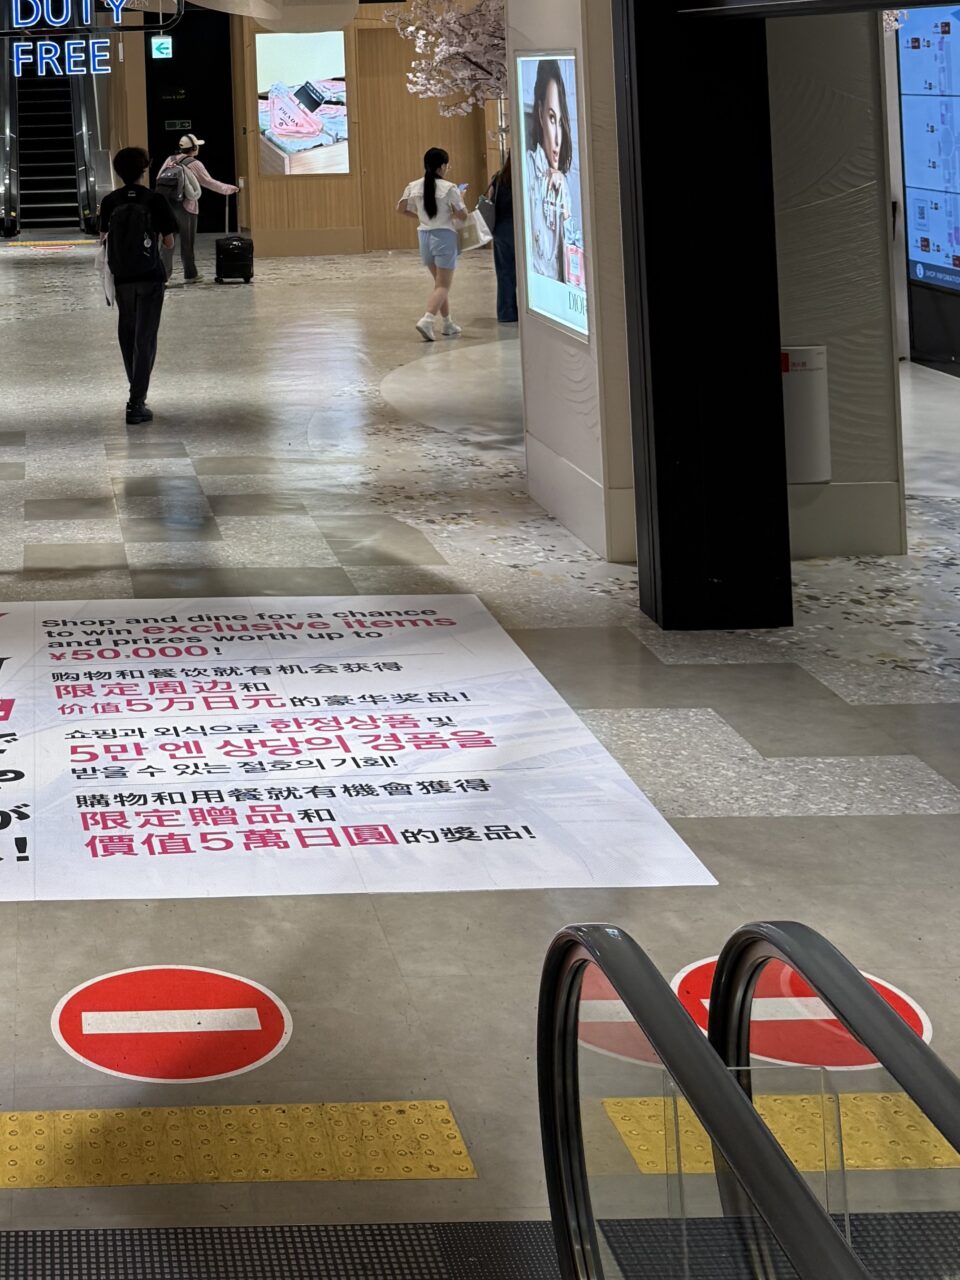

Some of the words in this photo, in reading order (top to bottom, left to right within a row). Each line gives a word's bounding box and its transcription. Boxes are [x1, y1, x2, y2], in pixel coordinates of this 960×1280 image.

[13, 38, 112, 77] FREE
[279, 106, 300, 128] PRADA
[41, 618, 115, 629] Shop
[124, 614, 177, 625] and
[186, 612, 248, 623] dine
[256, 611, 297, 620] for
[306, 611, 324, 619] a
[332, 607, 438, 618] chance
[45, 628, 74, 638] to
[82, 626, 133, 637] win
[141, 620, 331, 636] exclusive
[343, 616, 457, 629] items
[47, 637, 102, 648] and
[112, 634, 212, 648] prizes
[220, 631, 298, 642] worth
[306, 630, 345, 641] up
[353, 629, 384, 639] to
[51, 661, 404, 683] 购物和餐饮就有机会获得
[54, 679, 270, 699] 限定周边和
[57, 690, 471, 716] 价值5万日元的豪华奖品!
[64, 726, 147, 741] 쇼핑과
[153, 723, 264, 739] 외식으로
[266, 714, 422, 734] 한정상품
[427, 715, 458, 728] 및
[69, 741, 148, 764] 5만
[158, 738, 206, 761] 엔
[215, 733, 353, 760] 상당의
[359, 728, 497, 753] 경품을
[70, 764, 131, 781] 받을
[136, 763, 166, 778] 수
[173, 762, 233, 778] 있는
[238, 758, 328, 776] 절호의
[334, 754, 397, 771] 기회!
[75, 777, 492, 809] 購物和用餐就有機會獲得
[81, 804, 337, 832] 限定贈品和
